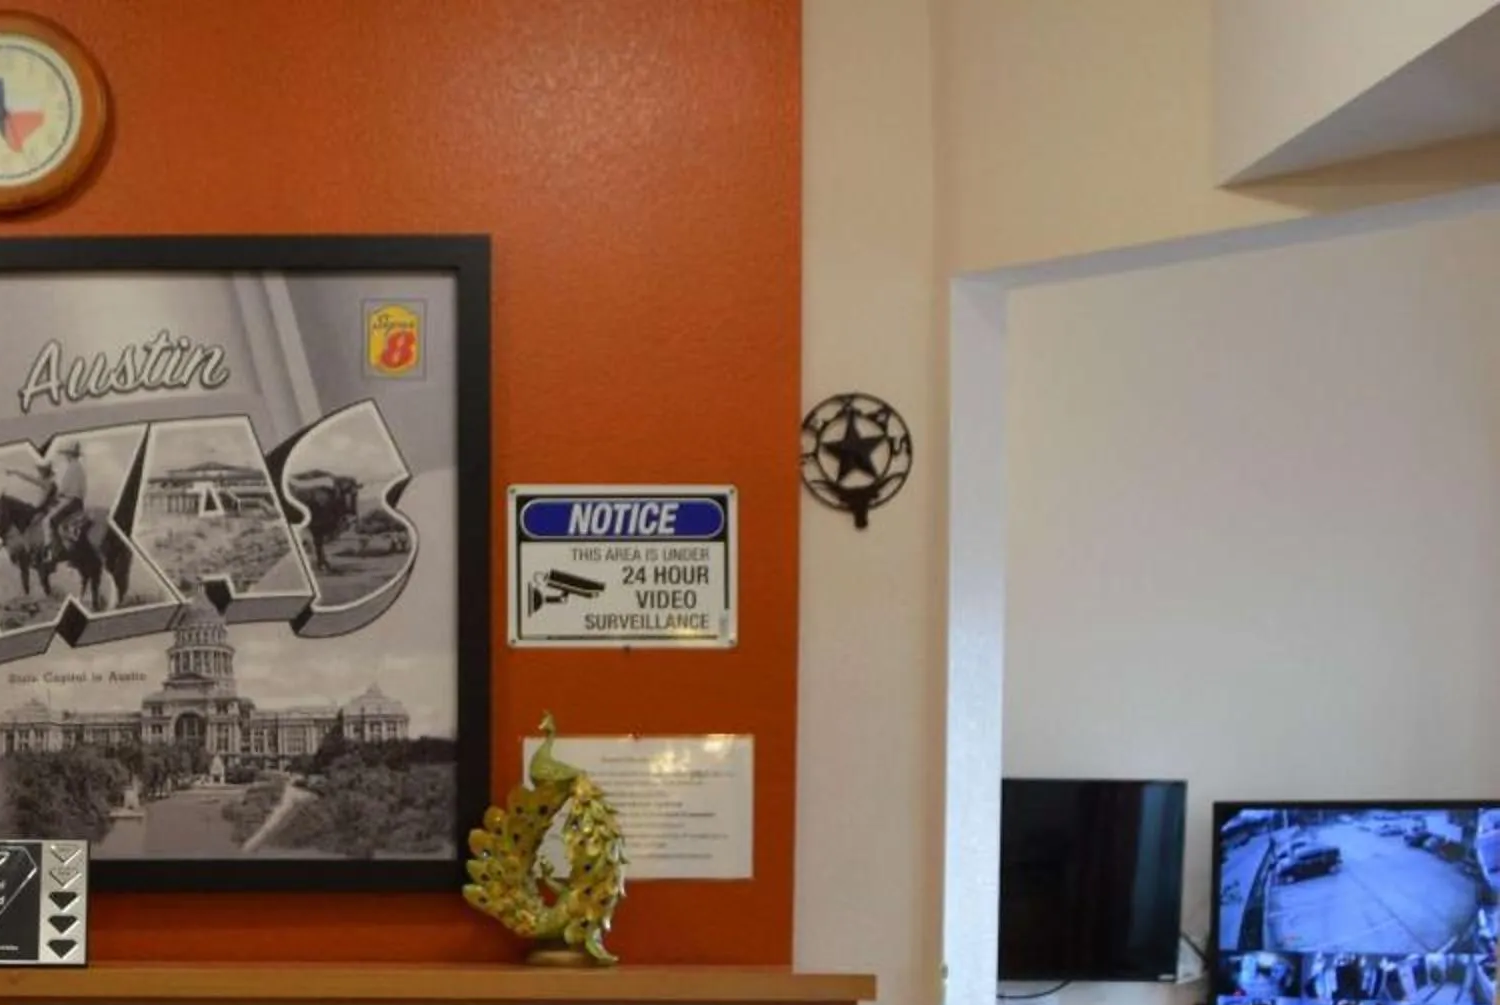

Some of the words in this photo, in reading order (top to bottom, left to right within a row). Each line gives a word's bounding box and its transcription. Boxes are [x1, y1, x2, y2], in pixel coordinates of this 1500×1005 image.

[381, 331, 417, 370] 8
[17, 328, 230, 414] Austin
[568, 502, 680, 535] NOTICE
[571, 548, 601, 561] THIS
[605, 548, 641, 561] AREA
[646, 548, 659, 561] IS
[663, 548, 710, 561] UNDER
[622, 565, 646, 585] 24
[653, 565, 710, 585] HOUR
[635, 590, 697, 609] VIDEO
[585, 613, 710, 630] SURVEILLANCE
